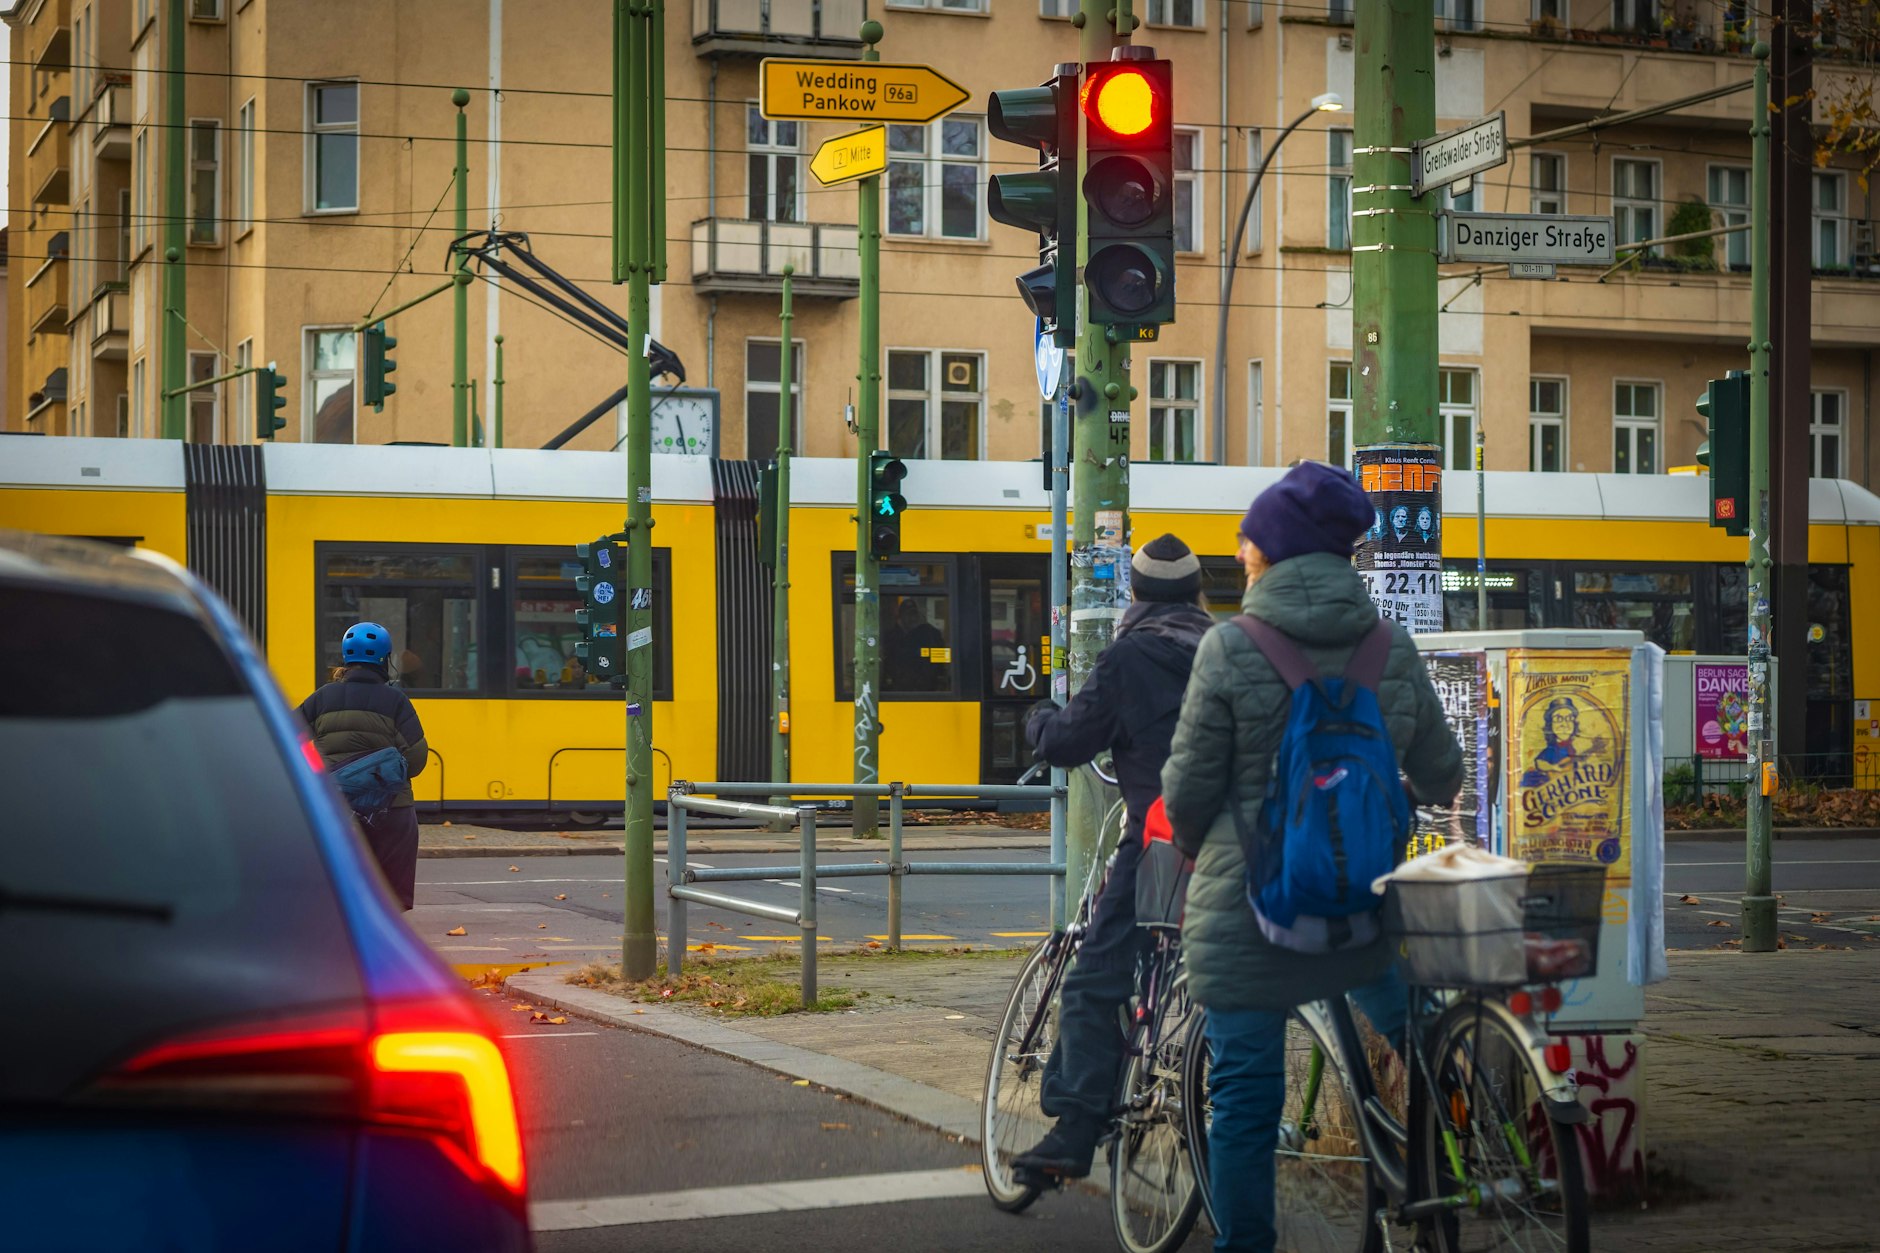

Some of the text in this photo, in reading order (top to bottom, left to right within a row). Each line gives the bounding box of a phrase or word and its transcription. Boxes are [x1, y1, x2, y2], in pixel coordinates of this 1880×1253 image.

[796, 71, 877, 94] Wedding
[803, 87, 913, 111] Pankow 96a
[850, 145, 871, 164] Mitte
[1424, 125, 1500, 174] Greifswalder Straße
[1457, 223, 1606, 253] Danziger Straße
[1521, 264, 1544, 273] 101-111
[1139, 328, 1154, 339] K6
[1367, 331, 1378, 343] 86
[1385, 456, 1402, 464] Klaus
[1363, 464, 1441, 492] RENF
[1374, 552, 1383, 560] Die
[1384, 551, 1415, 560] legendäre
[1374, 560, 1396, 568] Thomas
[1395, 601, 1410, 611] Uhr
[1560, 674, 1589, 684] MOND
[1698, 669, 1726, 678] BERLIN
[1699, 677, 1748, 692] DANKE
[1522, 761, 1613, 812] GERHARD
